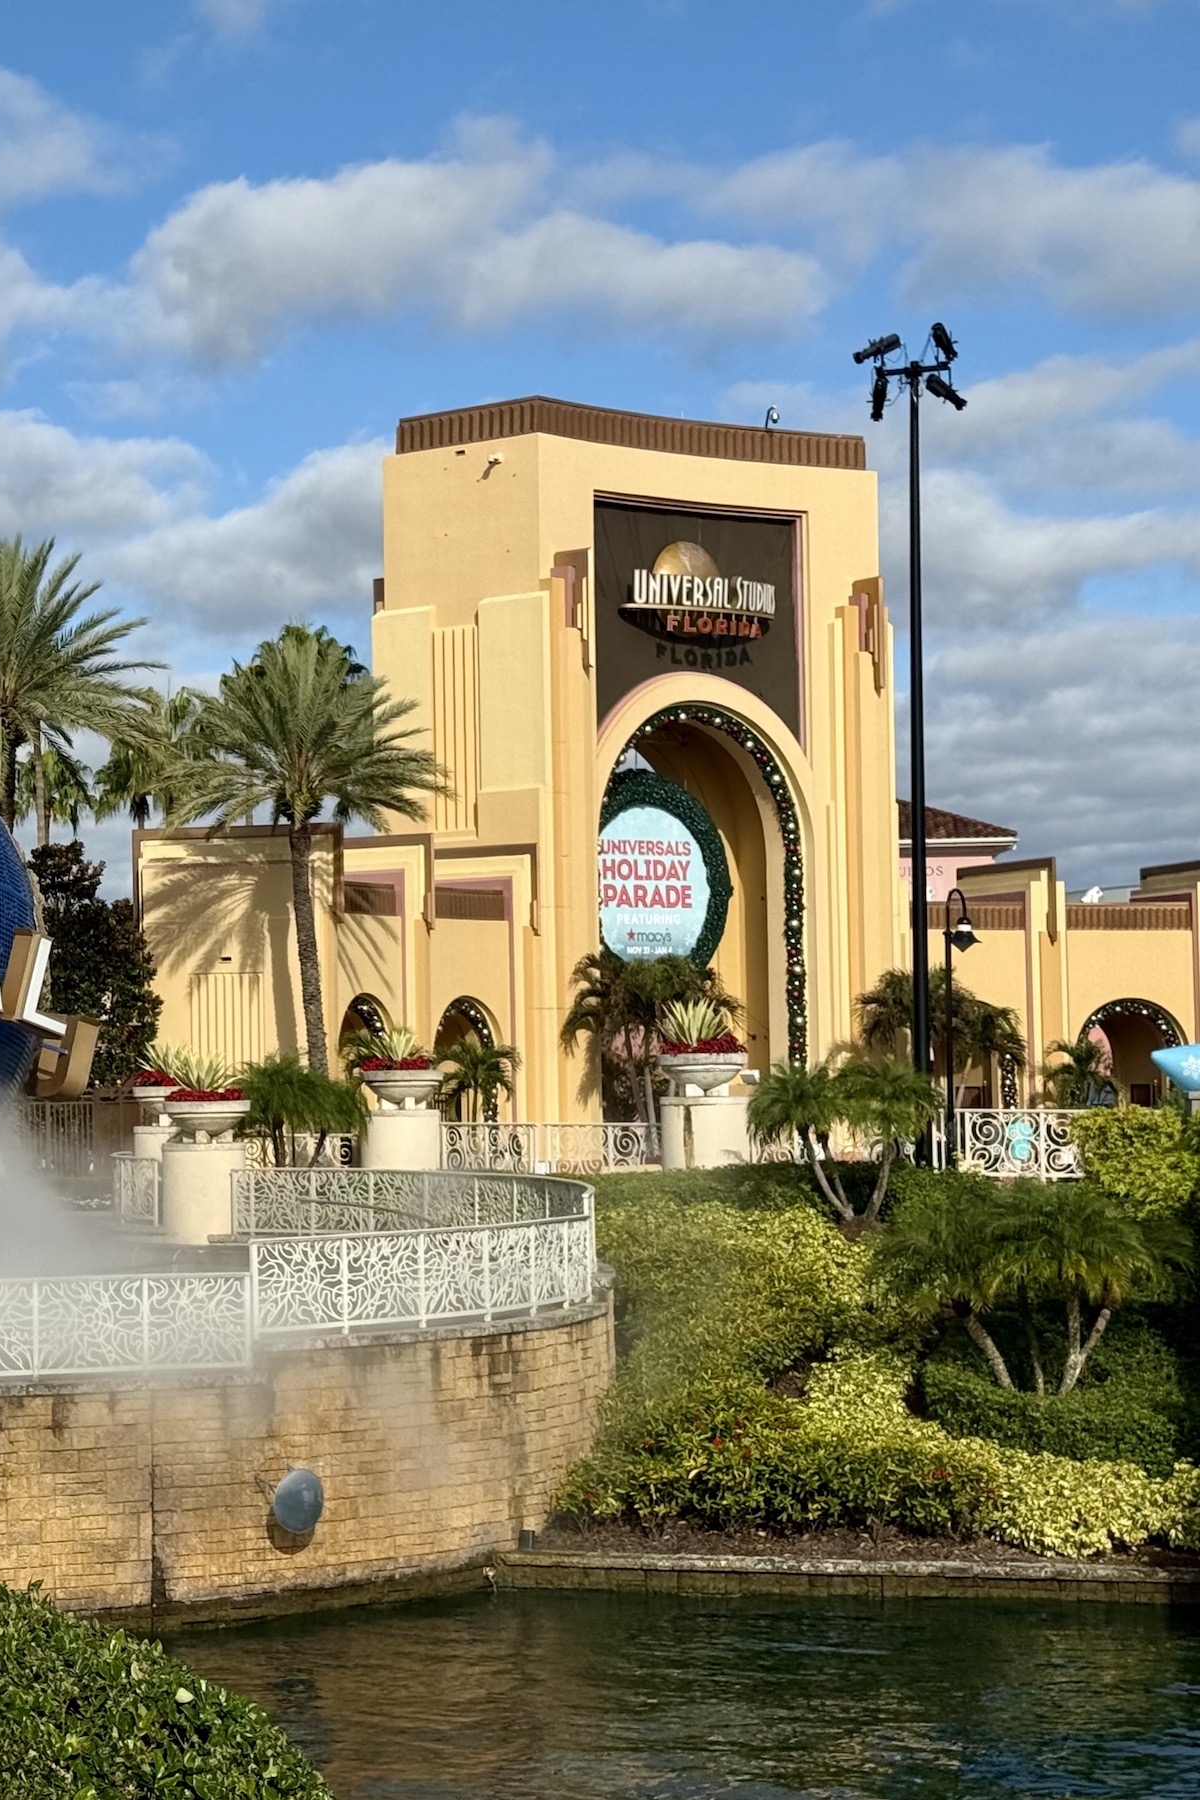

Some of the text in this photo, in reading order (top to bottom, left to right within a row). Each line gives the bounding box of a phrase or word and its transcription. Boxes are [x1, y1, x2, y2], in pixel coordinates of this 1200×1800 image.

[634, 569, 731, 608] UNIVERSAL
[666, 614, 763, 639] FLORIDA
[600, 838, 692, 857] UNIVERSAL'S
[602, 858, 691, 881] HOLIDAY
[603, 883, 693, 909] PARADE
[616, 912, 682, 925] FEATURING
[637, 927, 672, 944] macy's
[626, 945, 642, 954] NOV
